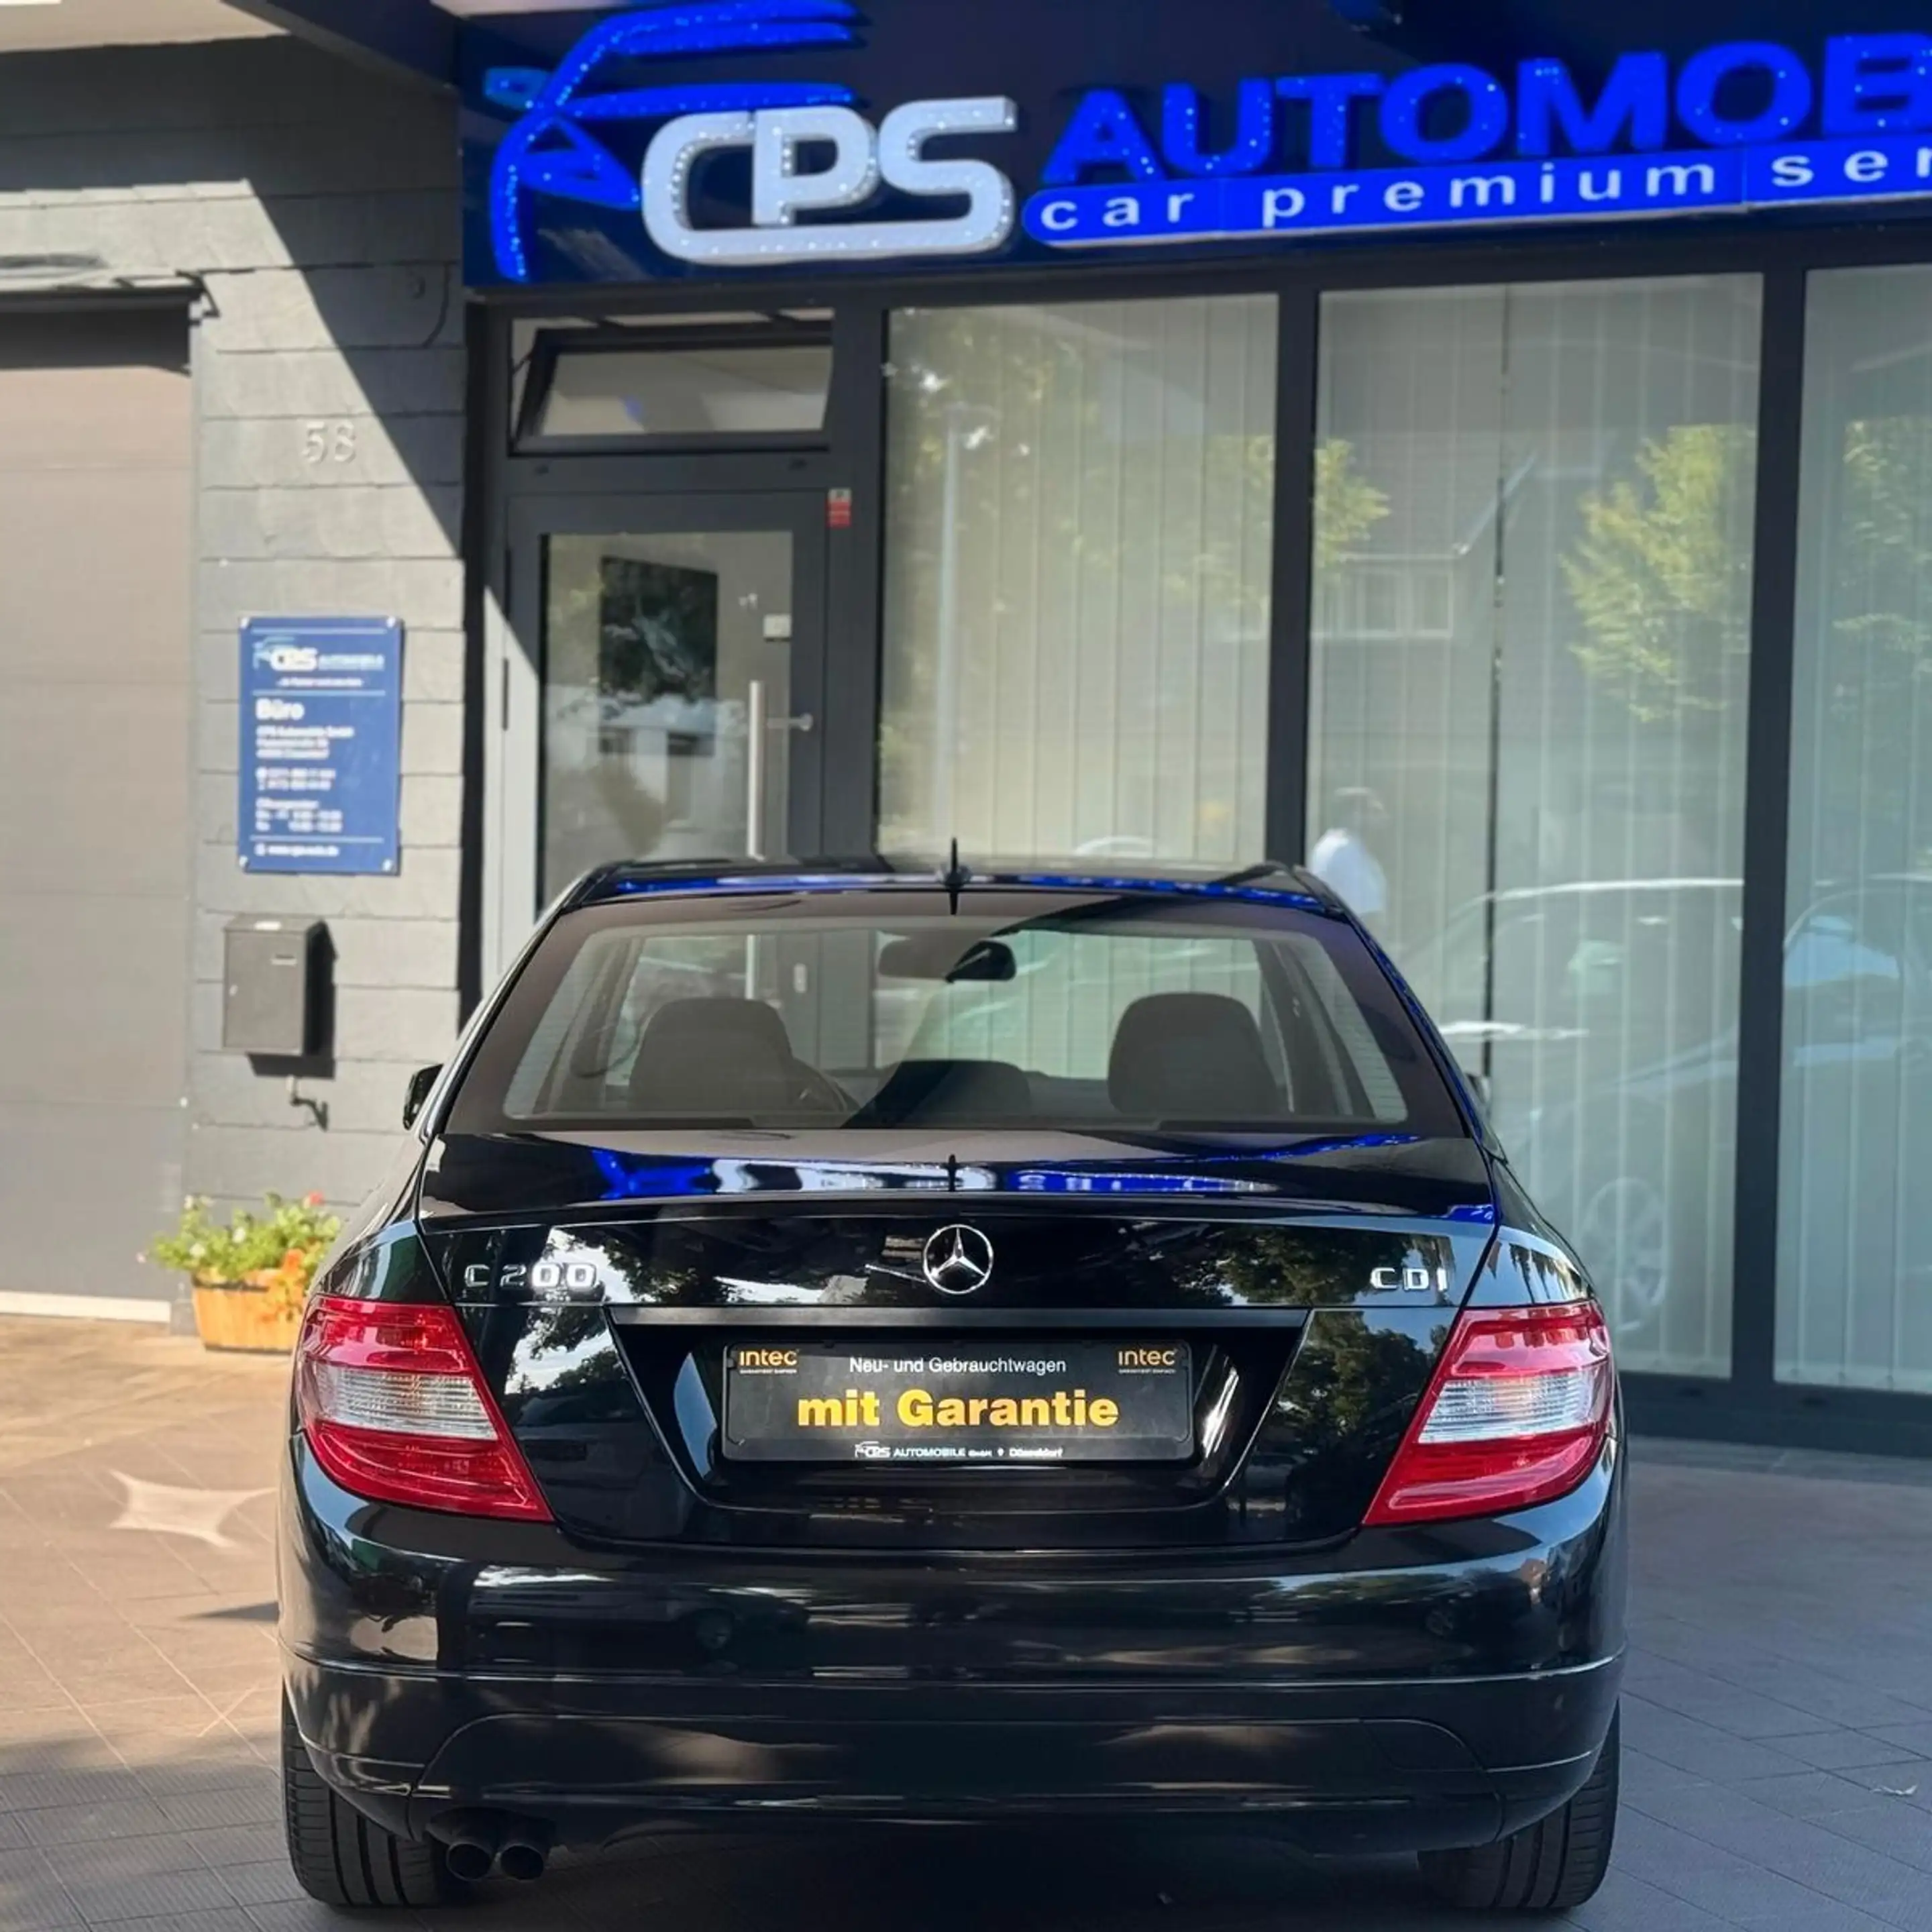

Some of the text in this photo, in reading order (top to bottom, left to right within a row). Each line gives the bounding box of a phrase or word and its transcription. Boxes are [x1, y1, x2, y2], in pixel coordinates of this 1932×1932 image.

[641, 32, 1932, 266] CPS AUTOMOB
[1040, 192, 1194, 231] car
[1262, 162, 1715, 229] premium
[302, 420, 356, 464] 58
[1370, 1267, 1448, 1291] CDI
[739, 1349, 798, 1366] intec
[849, 1357, 1067, 1375] Neu- und Gebrauchtwagen
[1118, 1349, 1175, 1366] intec
[798, 1389, 1118, 1428] mit Garantie
[894, 1447, 966, 1457] AUTOMOBILE
